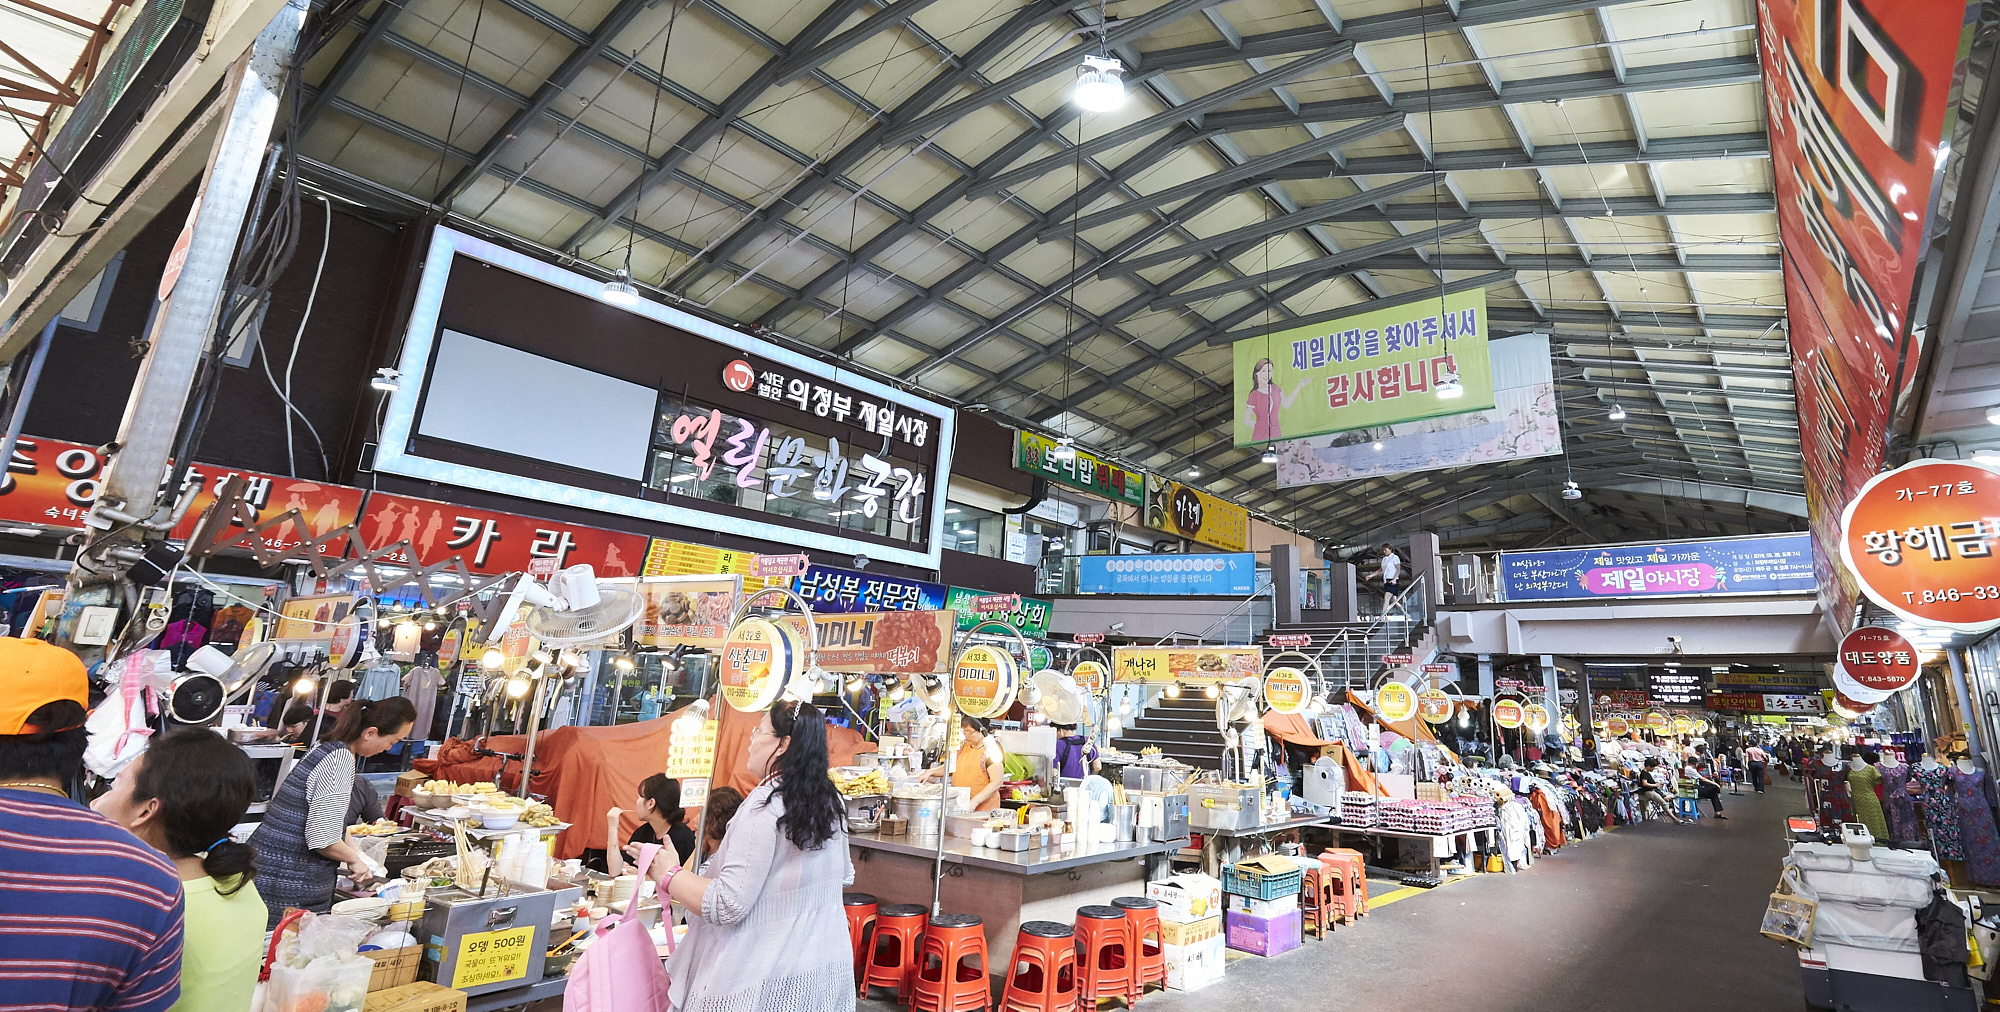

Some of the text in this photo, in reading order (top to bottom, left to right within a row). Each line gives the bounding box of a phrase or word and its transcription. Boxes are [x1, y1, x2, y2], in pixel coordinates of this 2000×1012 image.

[1292, 308, 1477, 370] 제일시장을 찾아주셔서
[759, 371, 784, 388] 사단
[757, 383, 782, 402] 법인
[787, 378, 929, 447] 의정부 제일시장
[856, 453, 926, 523] 공간
[1895, 480, 1977, 502] 가-77호
[1616, 555, 1644, 565] 맛있고
[1647, 553, 1668, 563] 제일
[1671, 552, 1701, 561] 가까운
[1600, 567, 1702, 592] 제일야시장
[799, 571, 861, 604] 남성복
[863, 583, 922, 611] 전문점
[1902, 584, 2000, 605] T.846-33
[728, 647, 768, 672] 삼촌네
[1844, 651, 1911, 665] 대도양품
[958, 667, 996, 682] 미미네
[468, 935, 526, 953] 오뎅 500원
